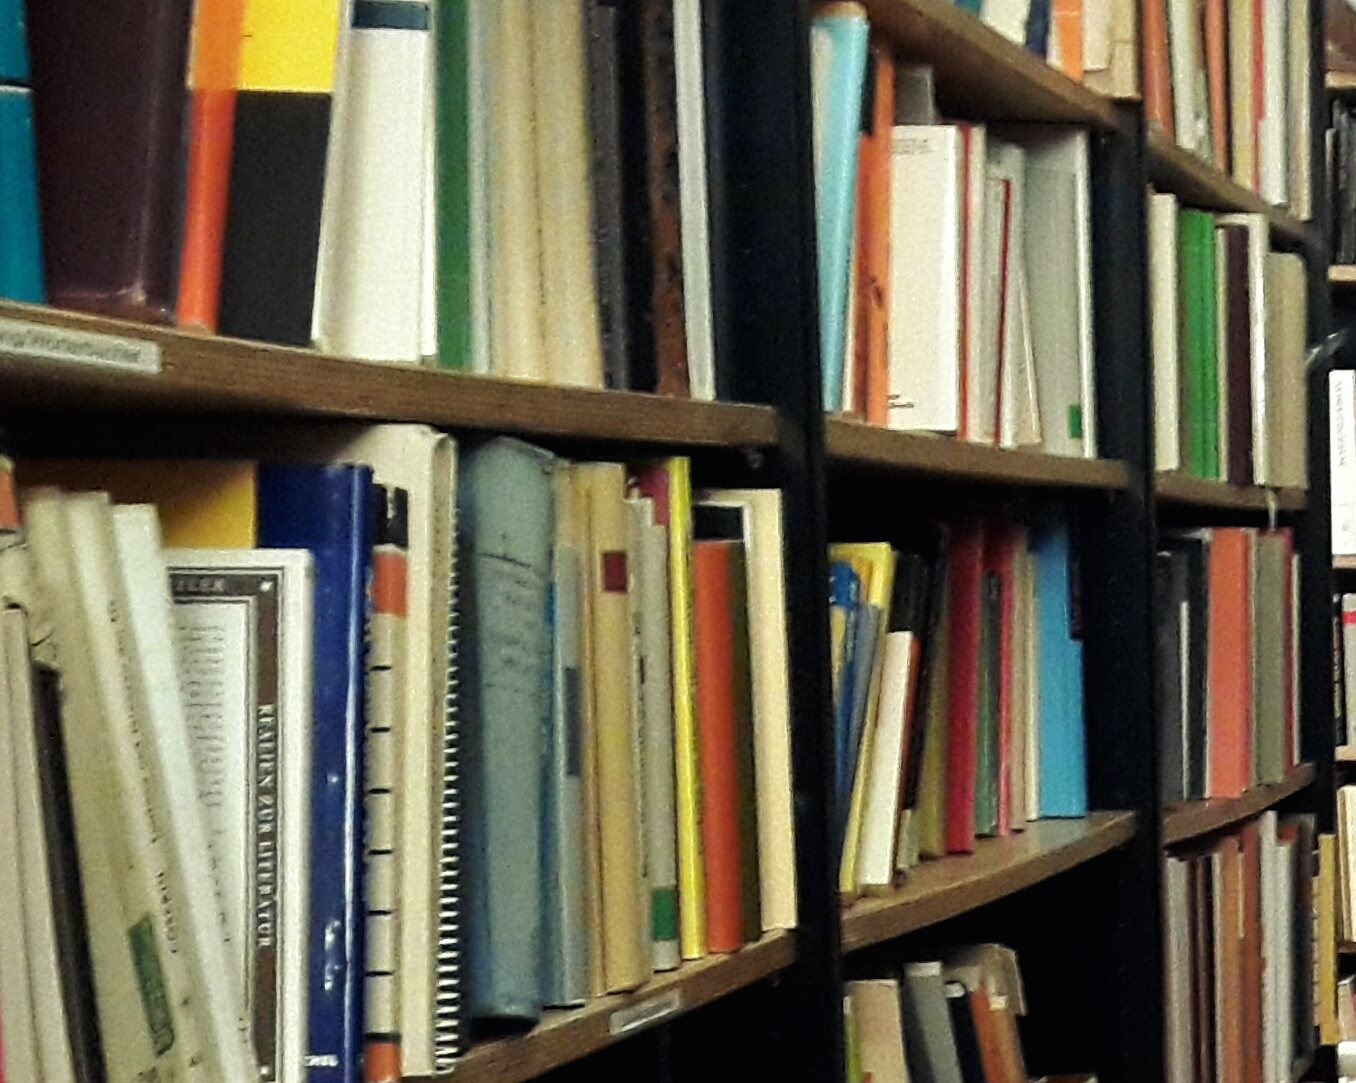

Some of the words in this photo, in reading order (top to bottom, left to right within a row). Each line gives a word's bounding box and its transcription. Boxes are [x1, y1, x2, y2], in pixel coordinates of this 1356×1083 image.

[256, 702, 275, 787] REALIEN
[254, 792, 274, 834] ZUR
[254, 840, 275, 948] LITERATUR
